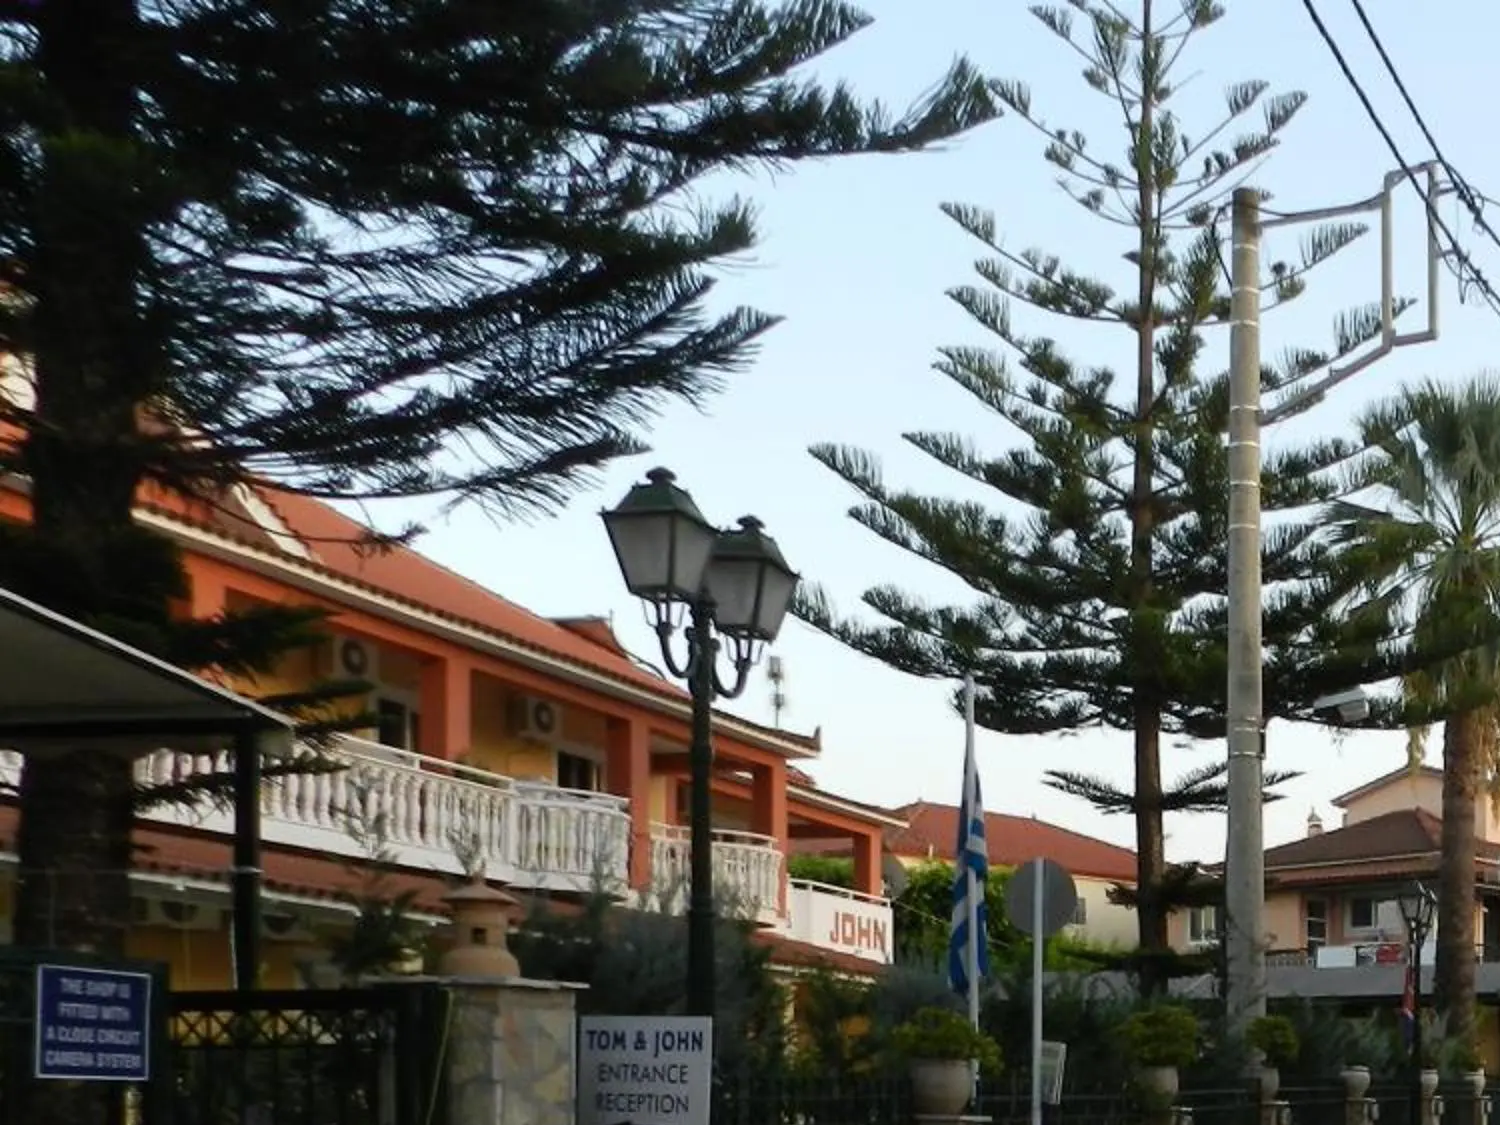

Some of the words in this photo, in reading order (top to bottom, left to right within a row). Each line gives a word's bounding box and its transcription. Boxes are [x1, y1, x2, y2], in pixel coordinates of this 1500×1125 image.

[829, 910, 887, 954] JOHN
[60, 977, 84, 995] THE
[58, 1002, 98, 1019] FITTED
[47, 1025, 56, 1040] A
[585, 1029, 627, 1051] TOM
[632, 1029, 648, 1051] &
[653, 1030, 704, 1058] JOHN
[95, 1052, 141, 1069] SYSTEM
[598, 1062, 689, 1085] ENTRANCE
[595, 1092, 690, 1115] RECEPTION
